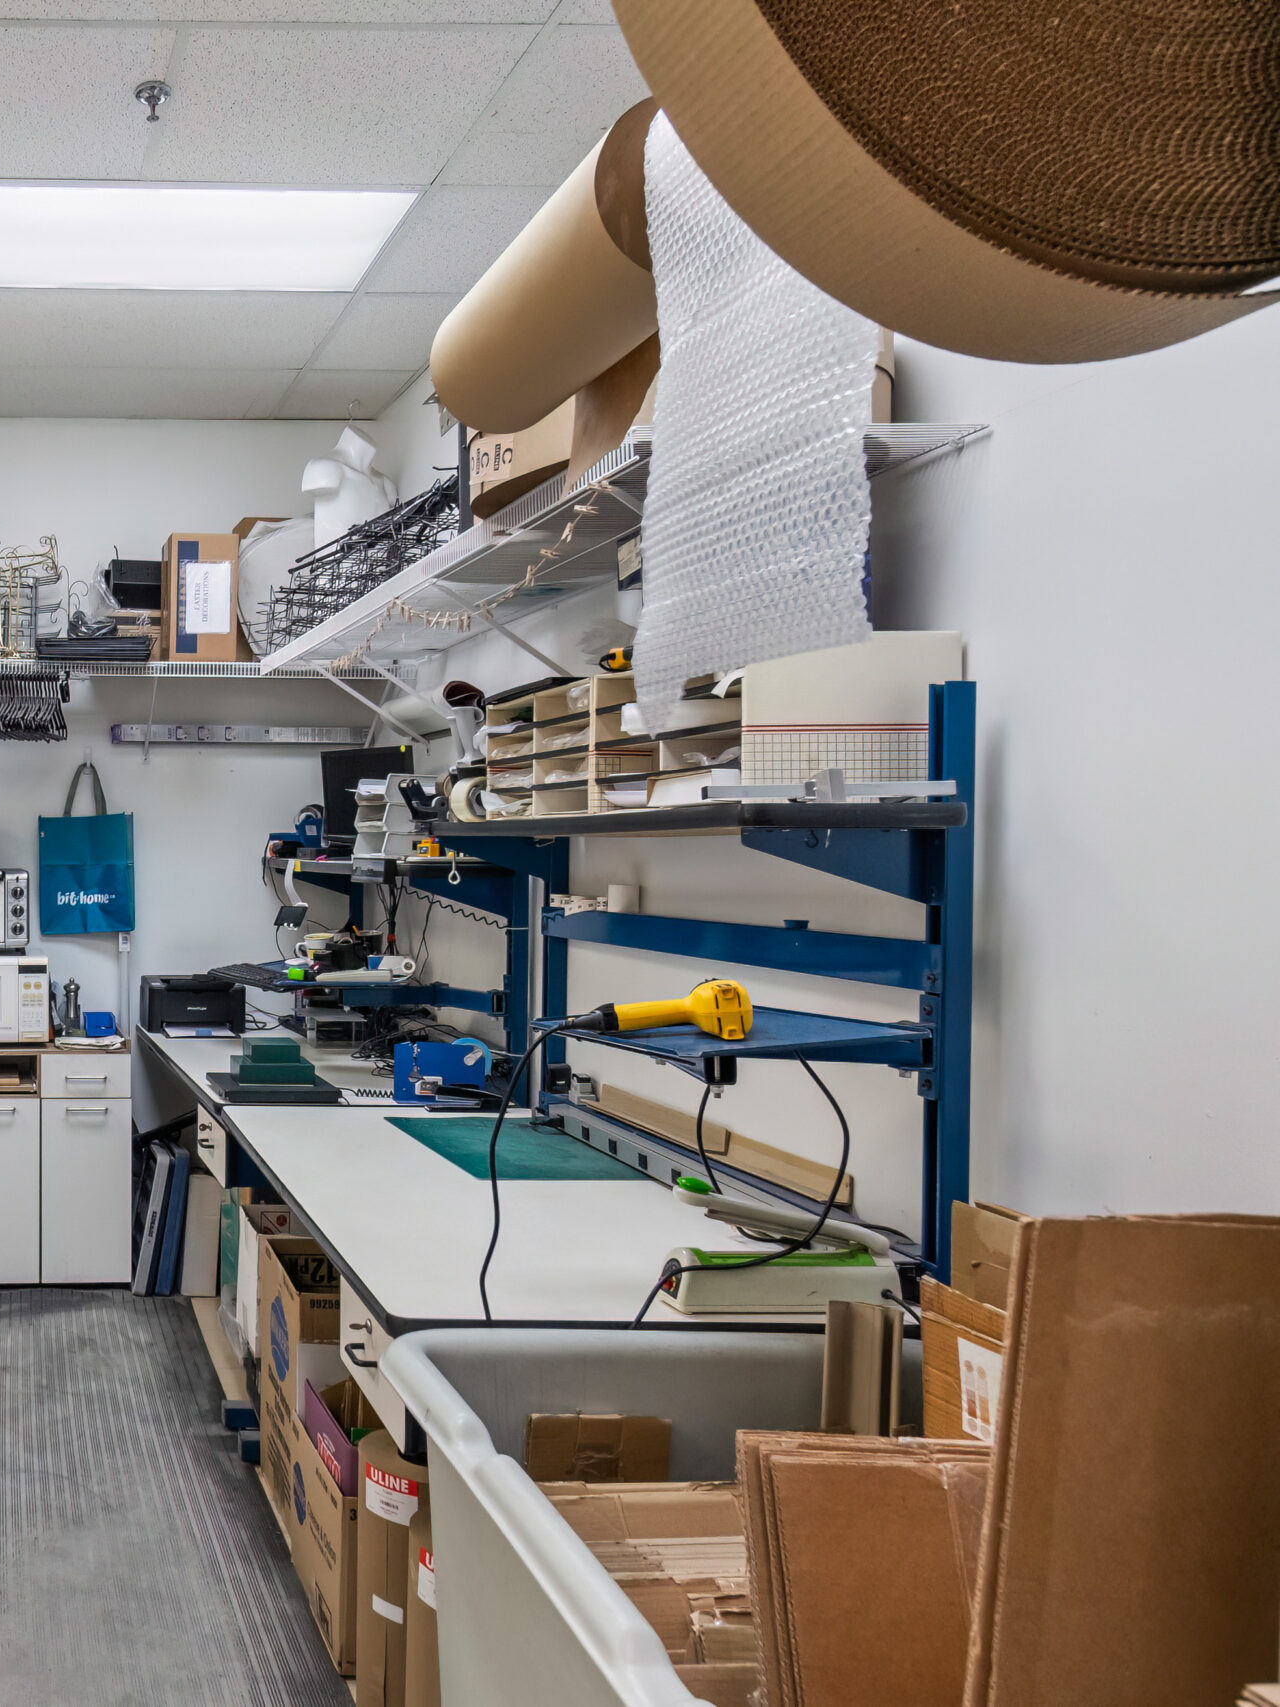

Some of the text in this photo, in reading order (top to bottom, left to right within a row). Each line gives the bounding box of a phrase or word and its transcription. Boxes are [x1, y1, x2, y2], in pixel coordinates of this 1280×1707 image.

[202, 571, 210, 623] DECORATIONS
[80, 890, 109, 905] home
[370, 1466, 410, 1494] ULINE
